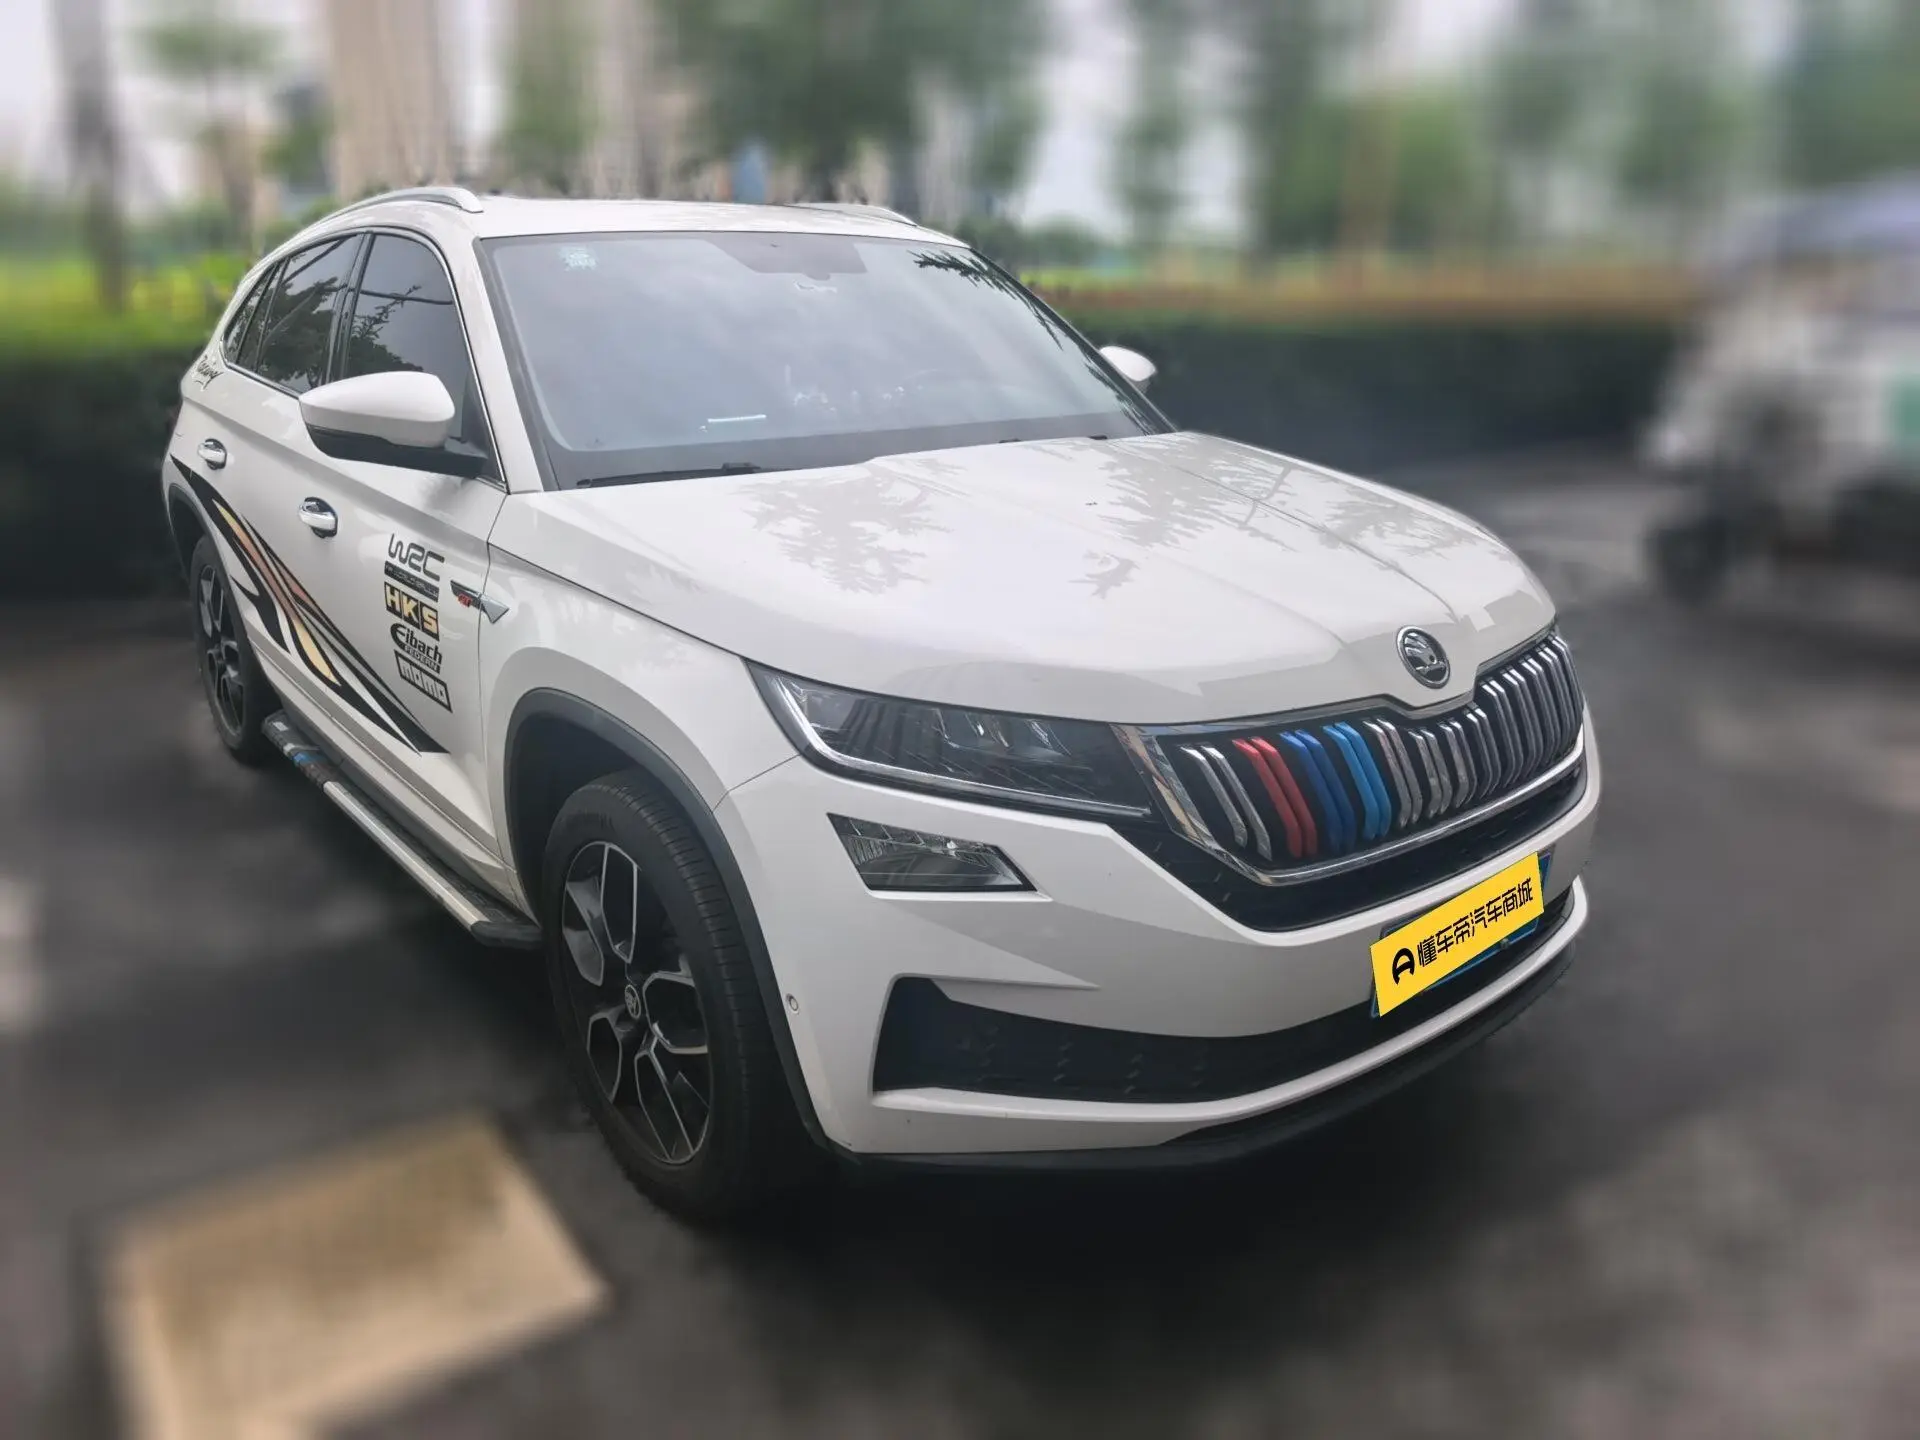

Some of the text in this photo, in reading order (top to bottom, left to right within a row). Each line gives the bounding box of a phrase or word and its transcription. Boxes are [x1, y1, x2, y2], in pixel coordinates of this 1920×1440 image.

[387, 533, 445, 582] WRC
[386, 583, 439, 636] HKS
[390, 622, 443, 664] Eibach
